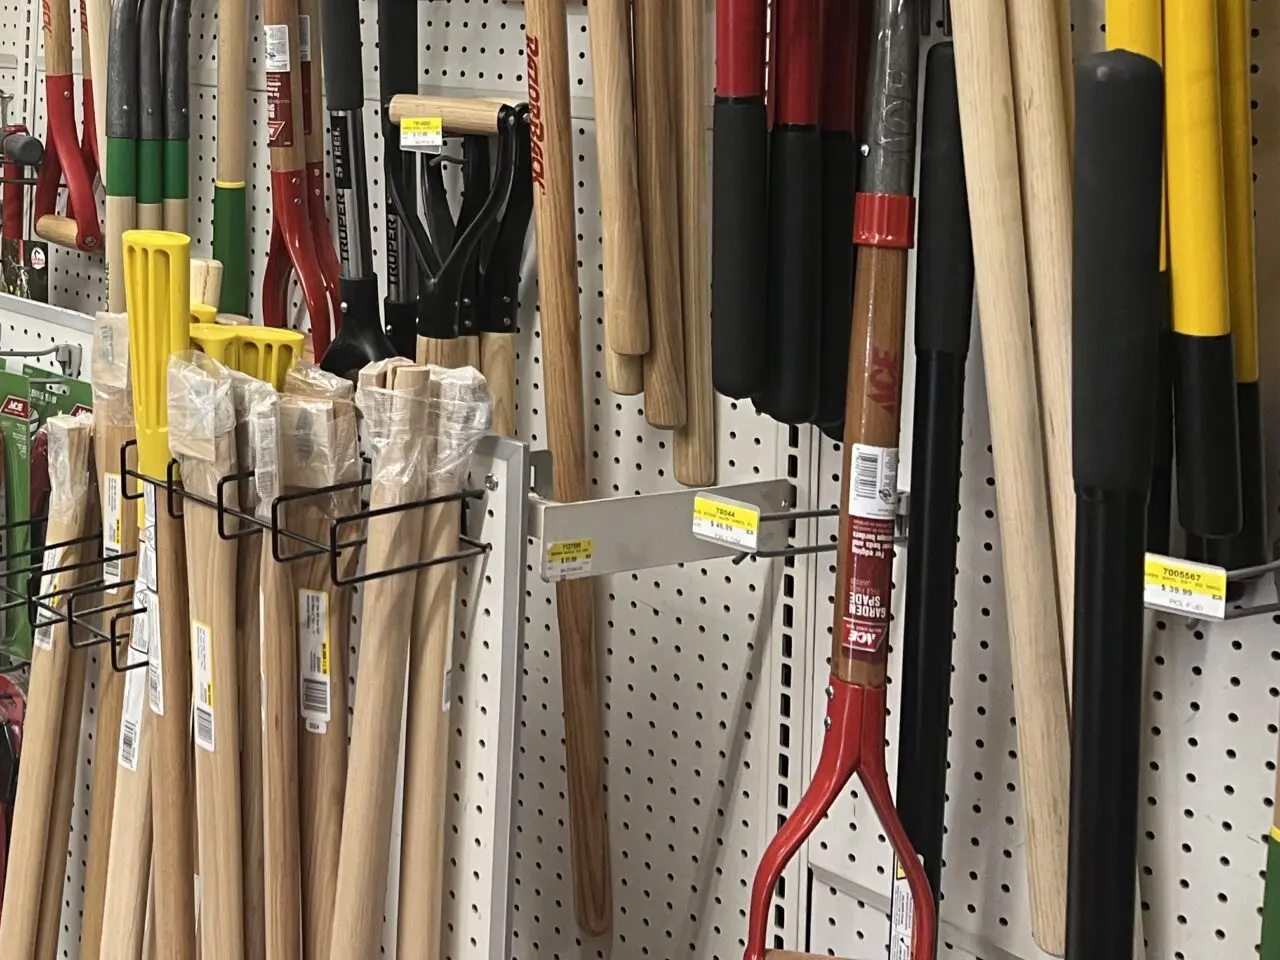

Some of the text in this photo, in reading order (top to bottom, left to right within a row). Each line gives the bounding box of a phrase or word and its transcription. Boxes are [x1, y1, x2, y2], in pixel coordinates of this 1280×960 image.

[332, 127, 349, 262] TRUPER STEEL
[387, 214, 398, 286] TRUPER
[8, 400, 23, 411] ACE
[1163, 567, 1202, 581] 7005567
[849, 591, 881, 607] SPADE
[849, 603, 887, 618] GARDEN
[848, 630, 876, 645] ACE
